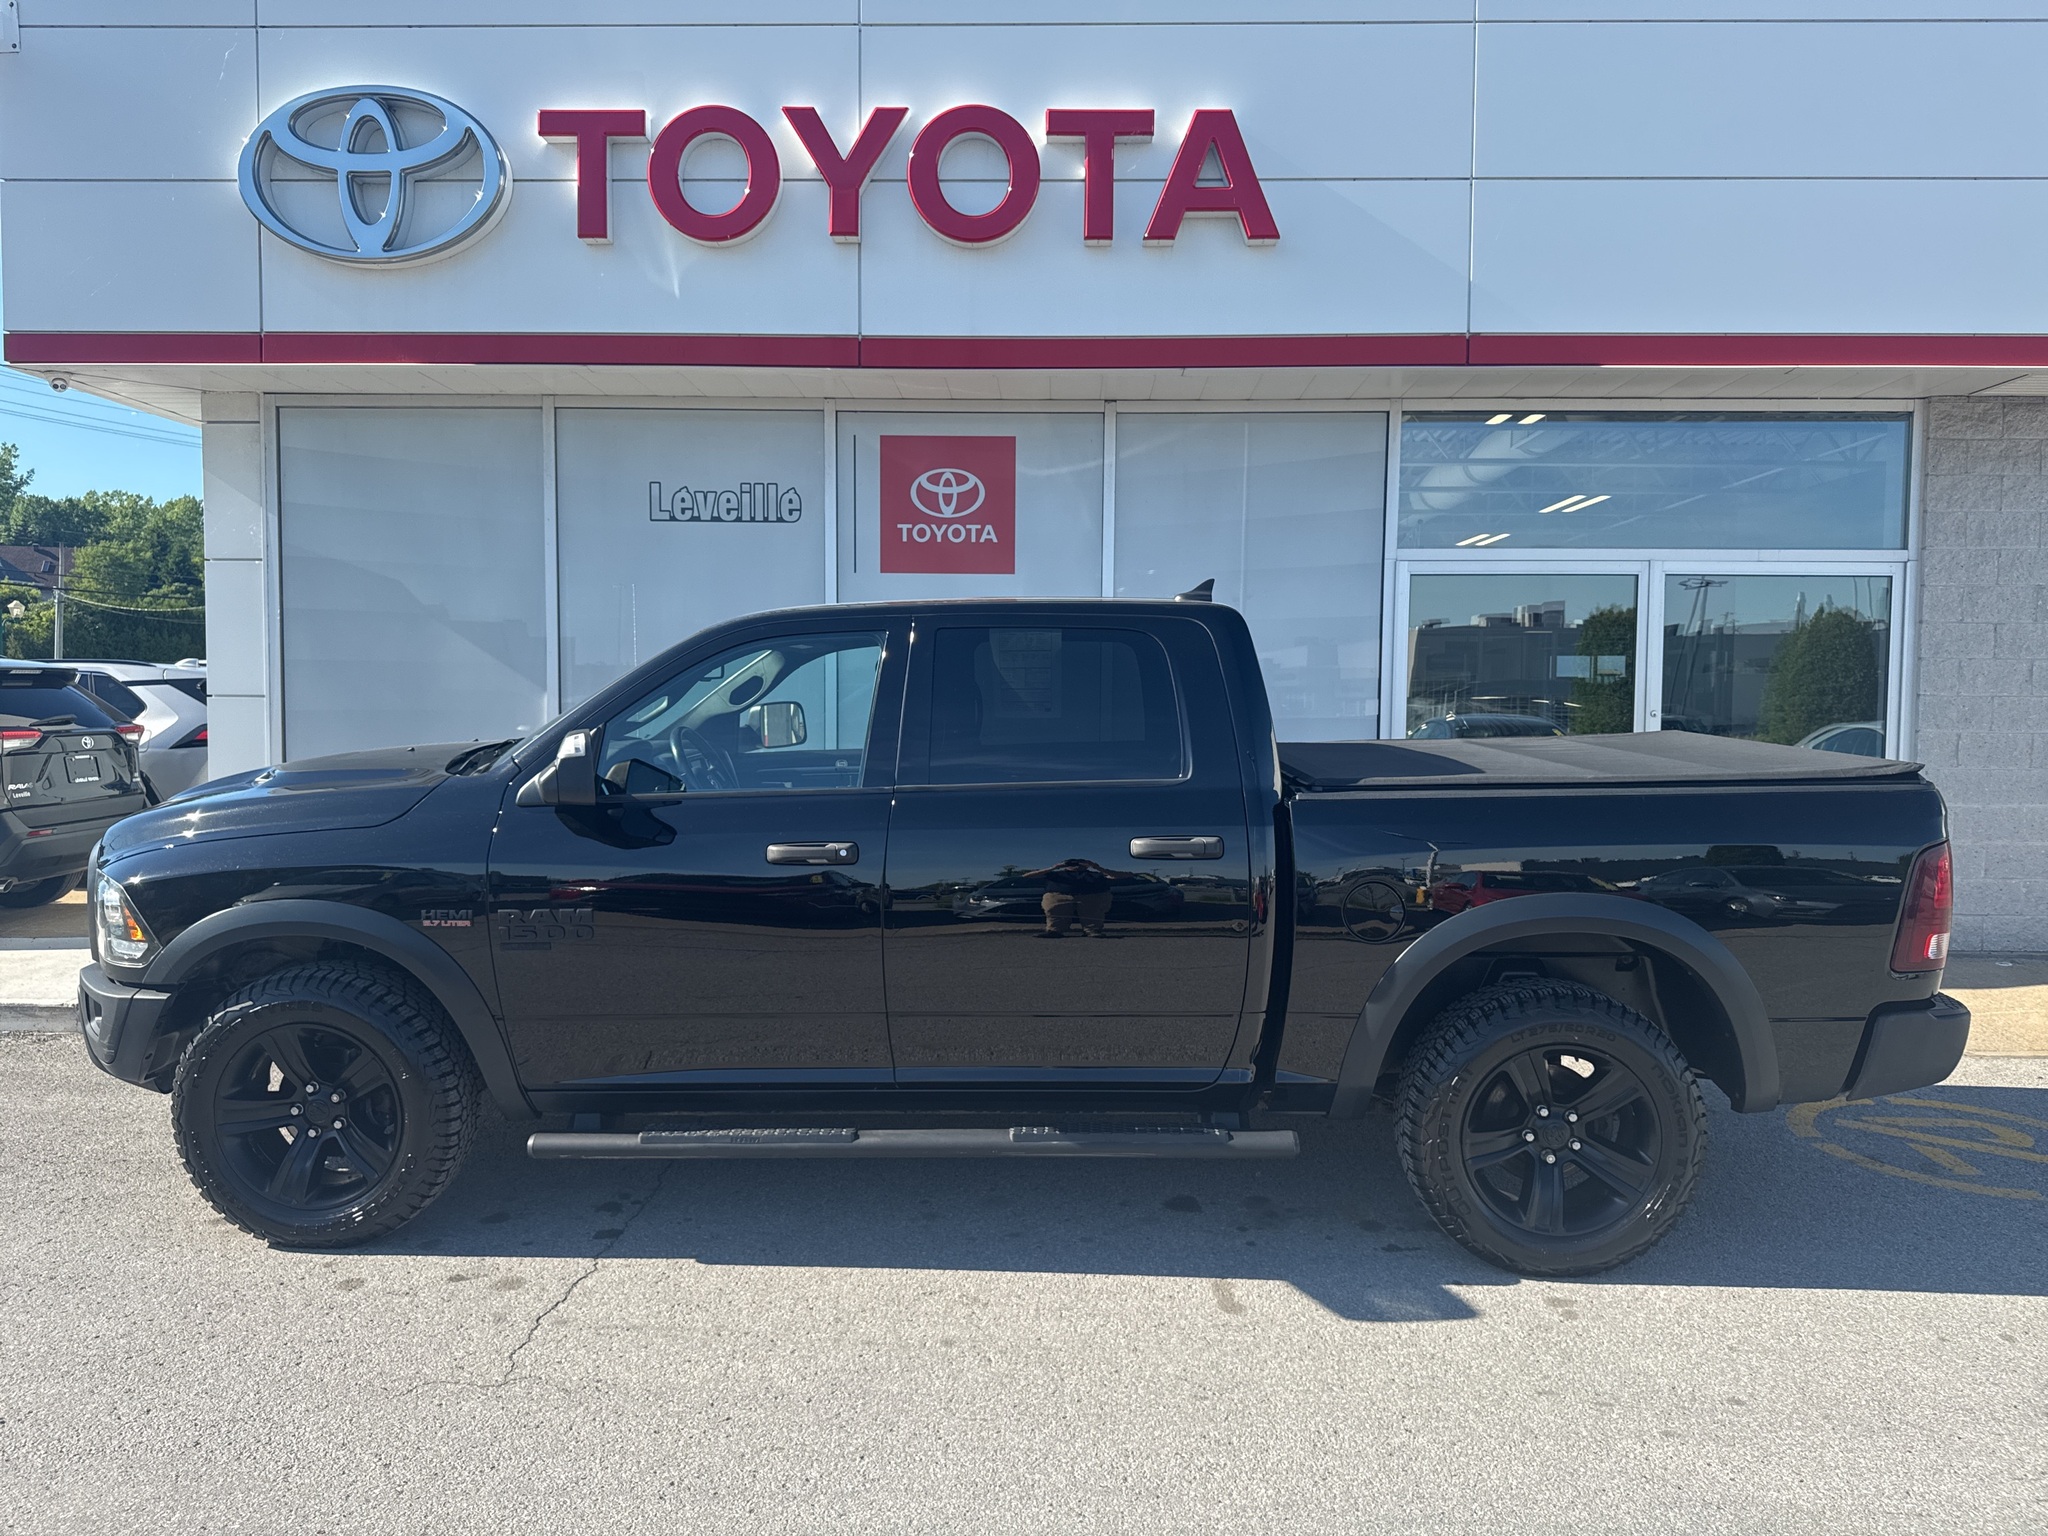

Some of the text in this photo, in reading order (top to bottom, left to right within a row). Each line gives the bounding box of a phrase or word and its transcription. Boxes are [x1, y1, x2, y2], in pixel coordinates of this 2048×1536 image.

[537, 104, 1281, 243] TOYOTA
[896, 523, 999, 544] TOYOTA
[420, 909, 473, 921] HEMI
[497, 908, 595, 924] RAM
[498, 925, 595, 941] 1500
